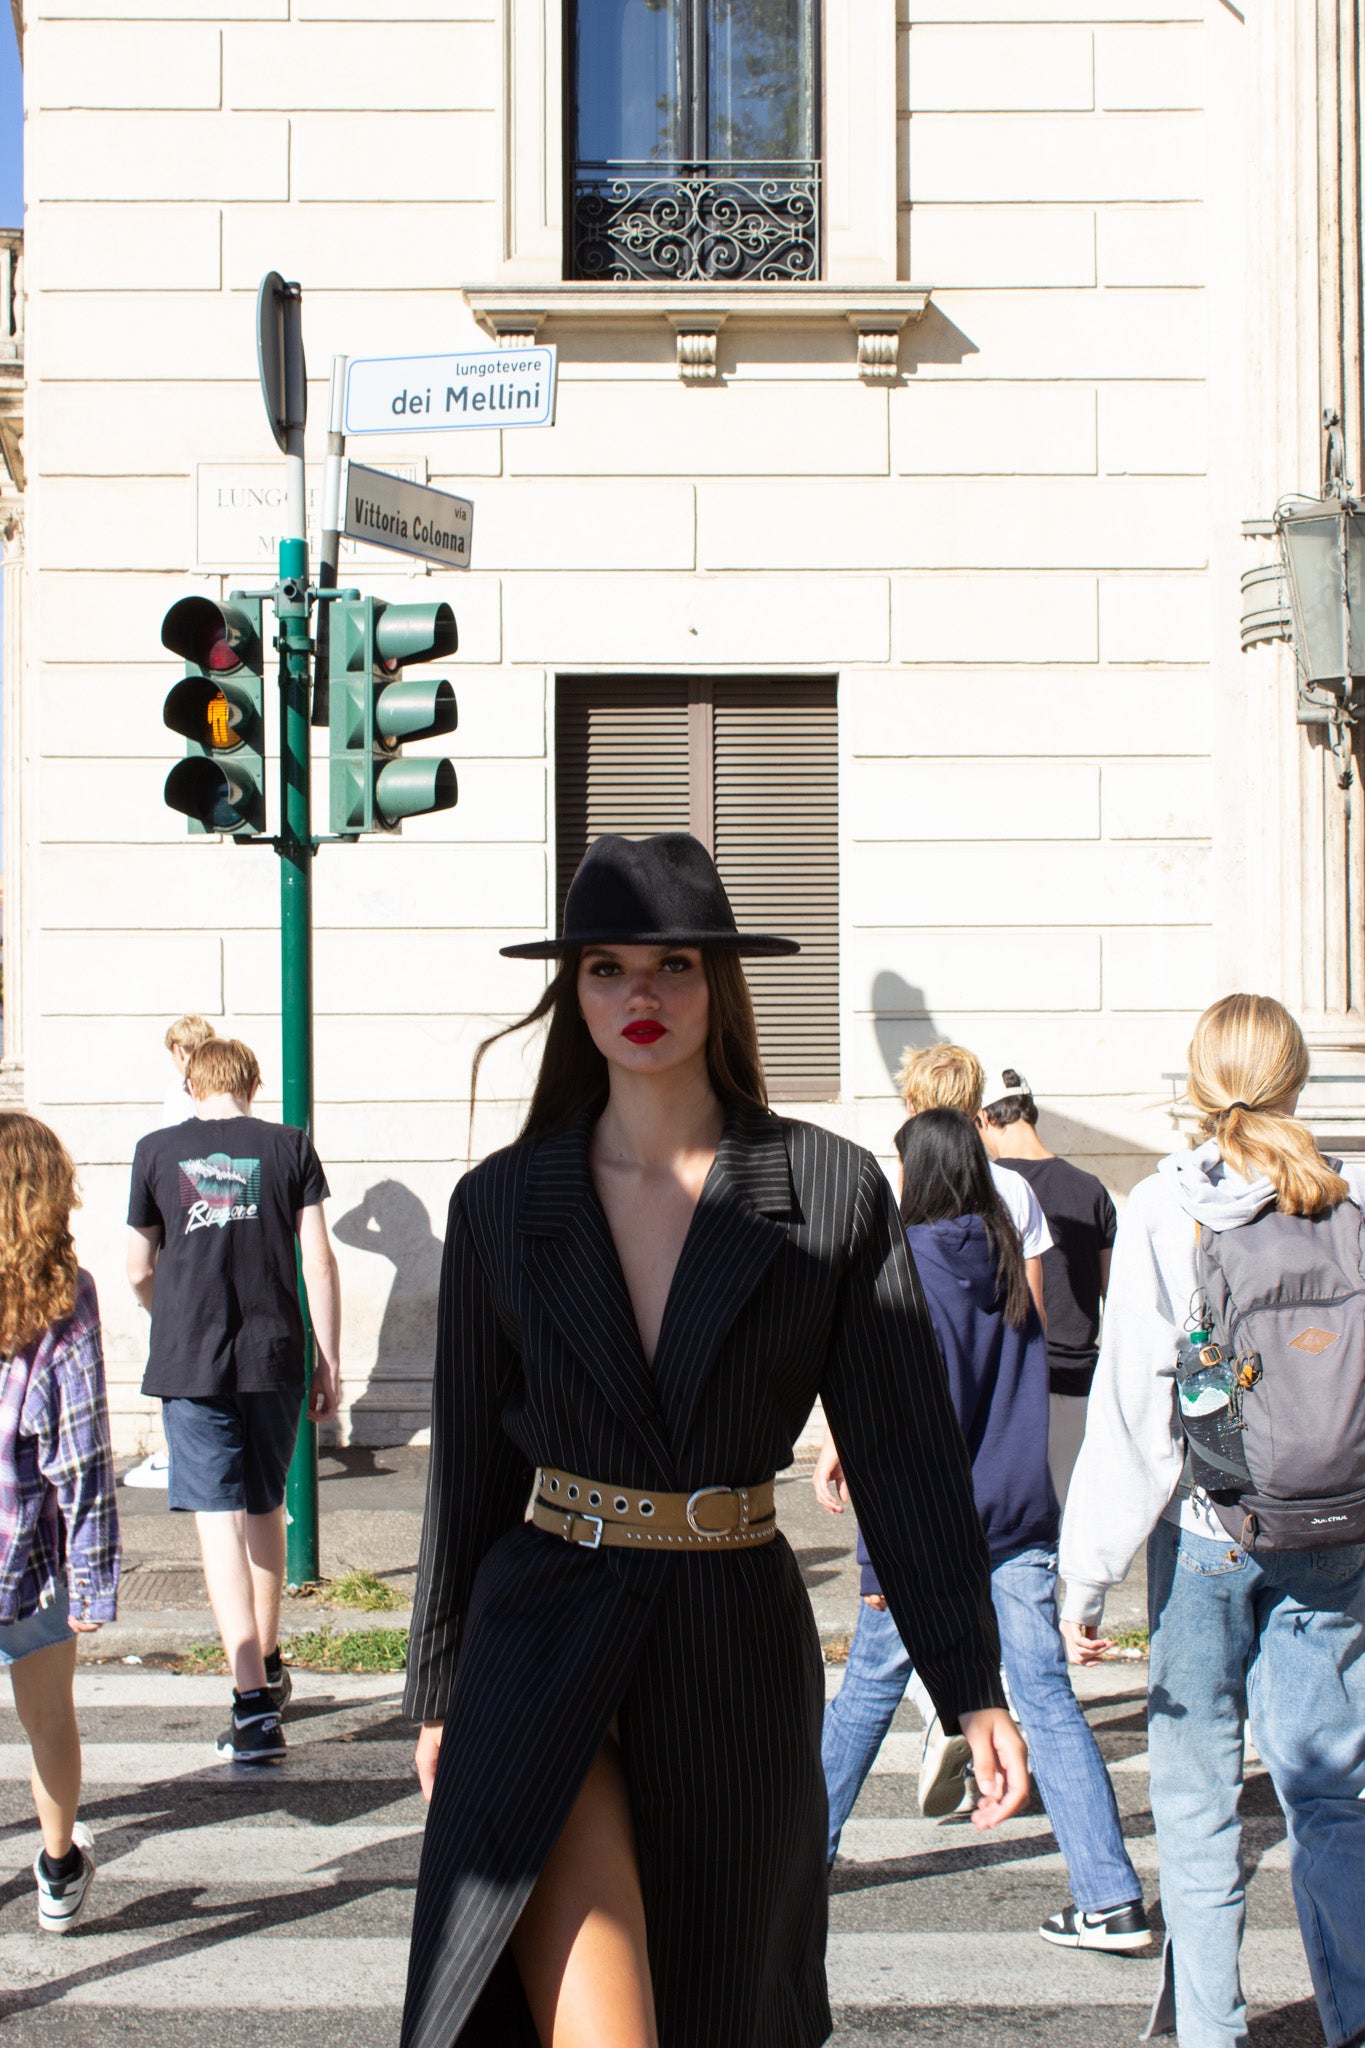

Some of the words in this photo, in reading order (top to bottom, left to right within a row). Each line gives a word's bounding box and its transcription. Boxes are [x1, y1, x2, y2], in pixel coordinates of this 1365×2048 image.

[456, 360, 542, 377] lungotevere
[392, 388, 431, 415] dei
[445, 382, 541, 412] Mellini
[355, 497, 408, 538] Vittoria
[413, 516, 465, 554] Colonna
[454, 506, 467, 521] via
